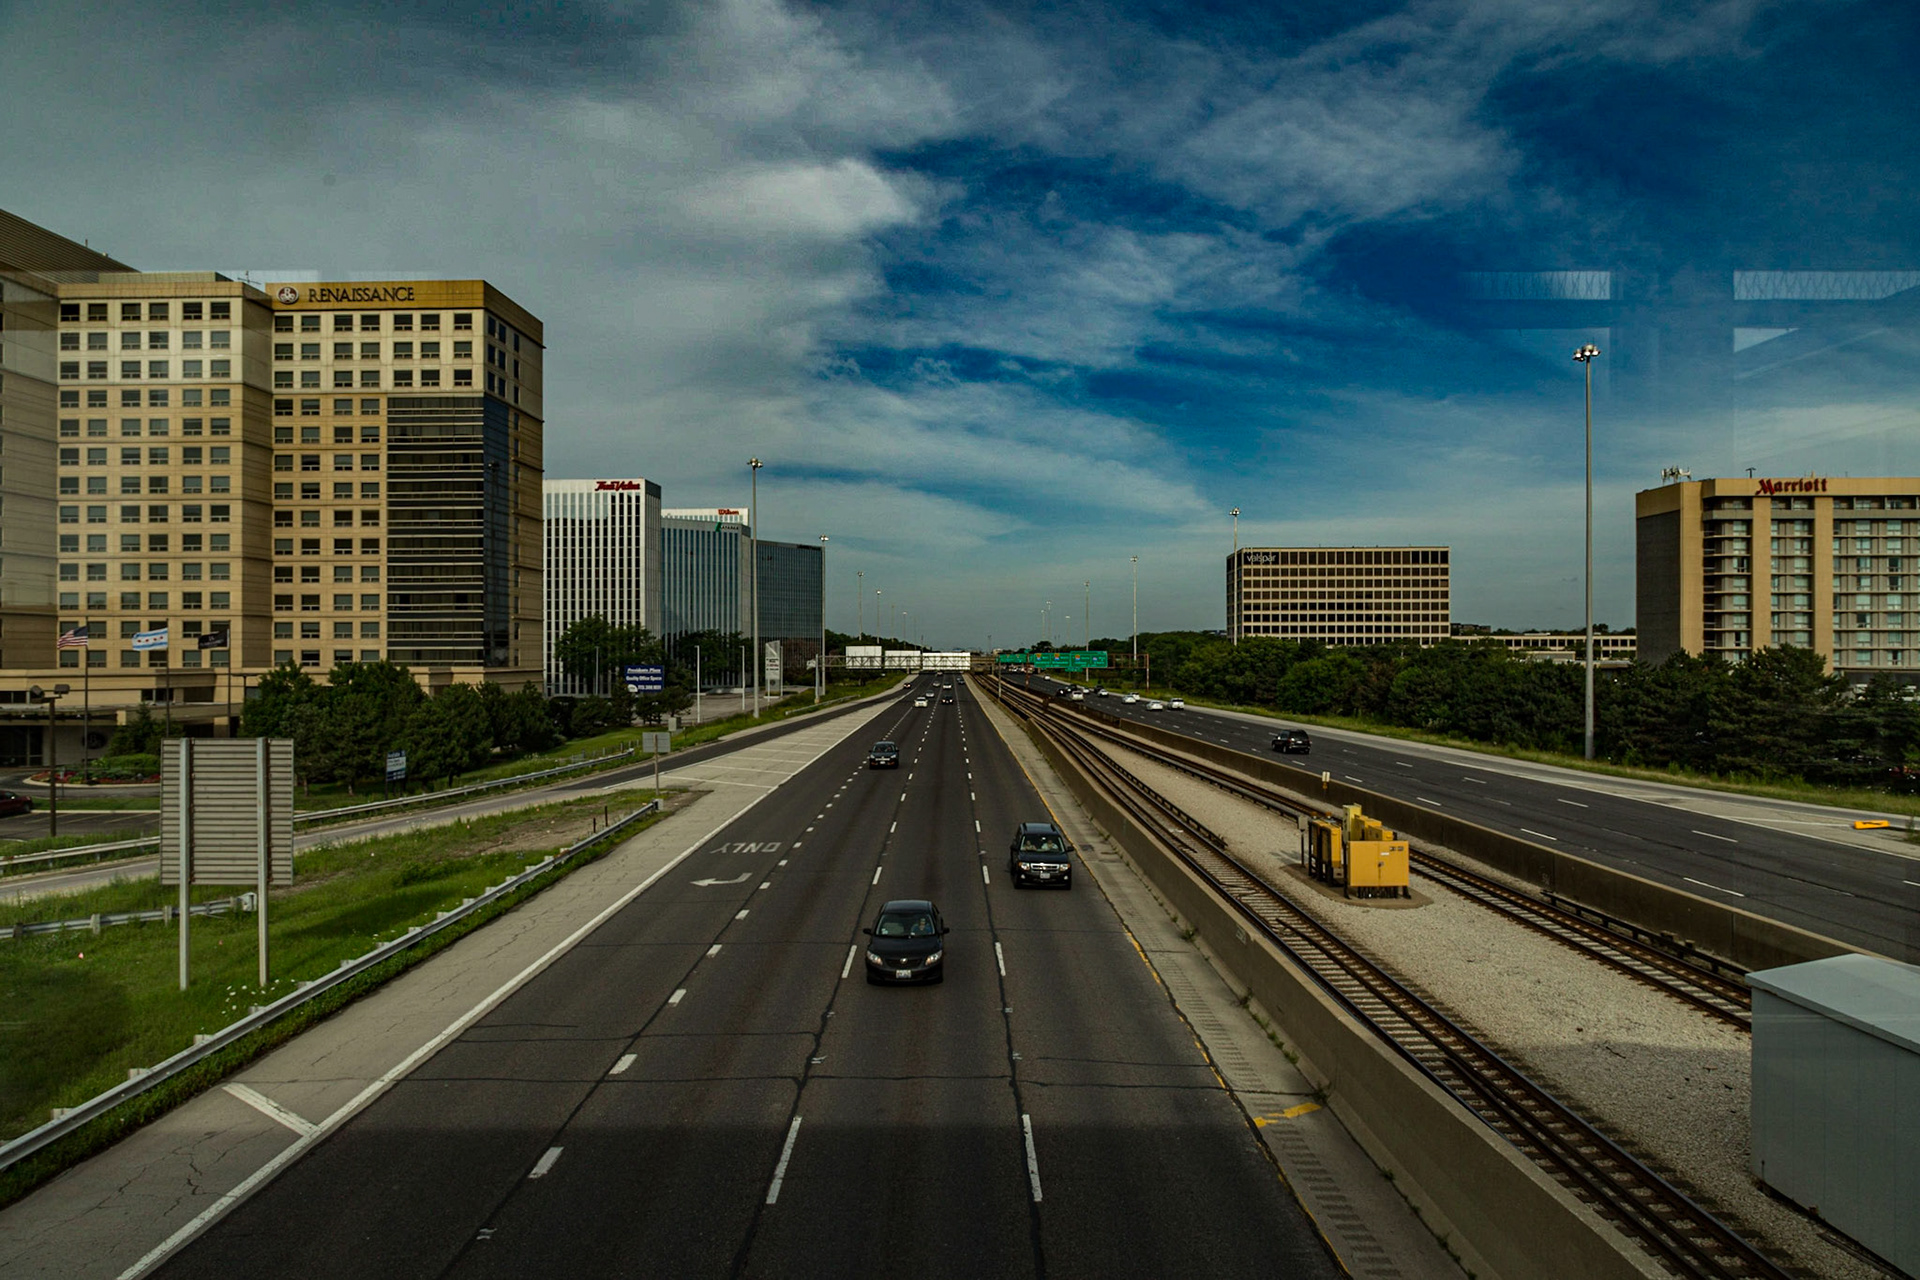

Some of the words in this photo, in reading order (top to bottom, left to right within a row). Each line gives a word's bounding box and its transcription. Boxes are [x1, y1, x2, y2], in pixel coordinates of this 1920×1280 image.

[308, 287, 414, 302] RENAISSANCE
[1755, 478, 1828, 495] Marriott
[710, 842, 782, 854] ONLY
